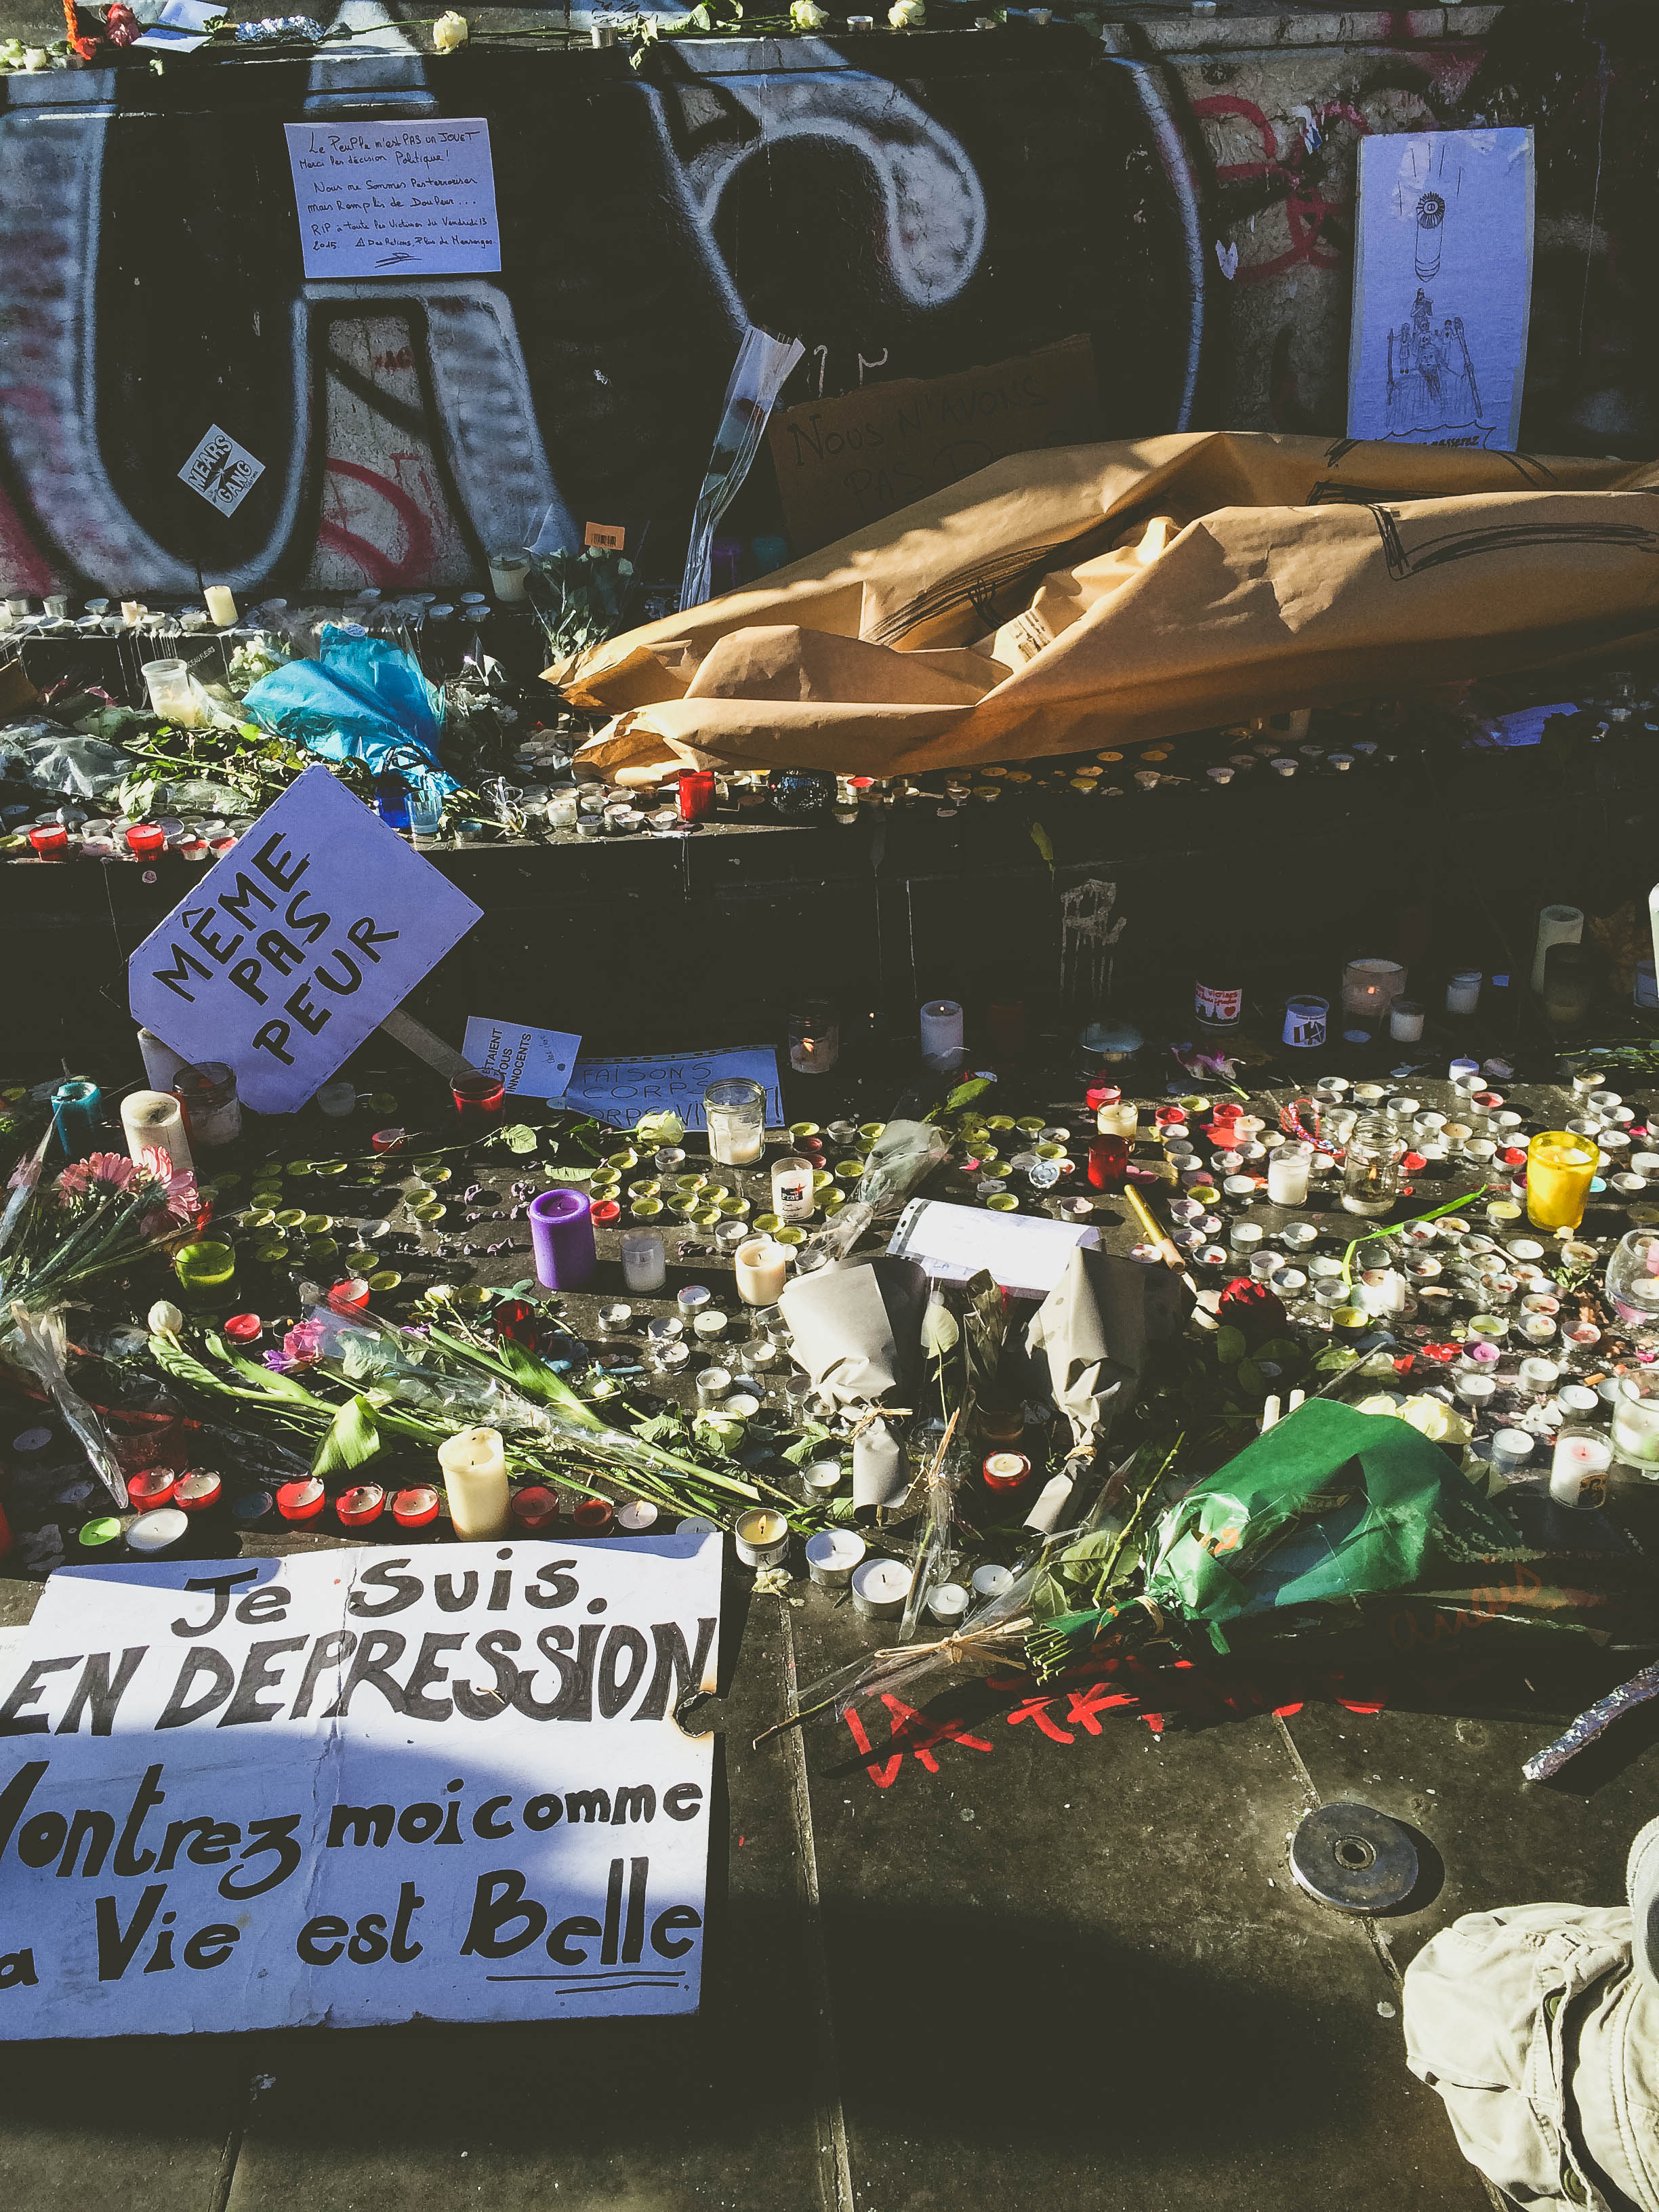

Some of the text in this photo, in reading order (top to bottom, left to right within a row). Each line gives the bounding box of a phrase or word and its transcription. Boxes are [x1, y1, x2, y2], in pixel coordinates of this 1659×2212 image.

[299, 159, 325, 169] Merci
[309, 131, 325, 153] Le
[403, 134, 422, 145] PAS
[438, 131, 480, 142] JOUET
[314, 181, 343, 193] Nous
[390, 196, 405, 207] de
[311, 222, 331, 236] RIP
[427, 218, 438, 226] du
[188, 434, 232, 493] MEARS
[217, 460, 252, 503] GANG
[152, 832, 311, 1003] MÊME
[228, 890, 331, 1006] PAS
[252, 917, 400, 1067] PEUR
[506, 1033, 532, 1092] INNOCENTS
[582, 1081, 710, 1099] CORPS
[171, 1568, 291, 1639] Je
[0, 1618, 717, 1736] EN DEPRESSION
[95, 1883, 241, 1982] Vie
[295, 1881, 424, 1966] est
[459, 1856, 703, 1967] Belle
